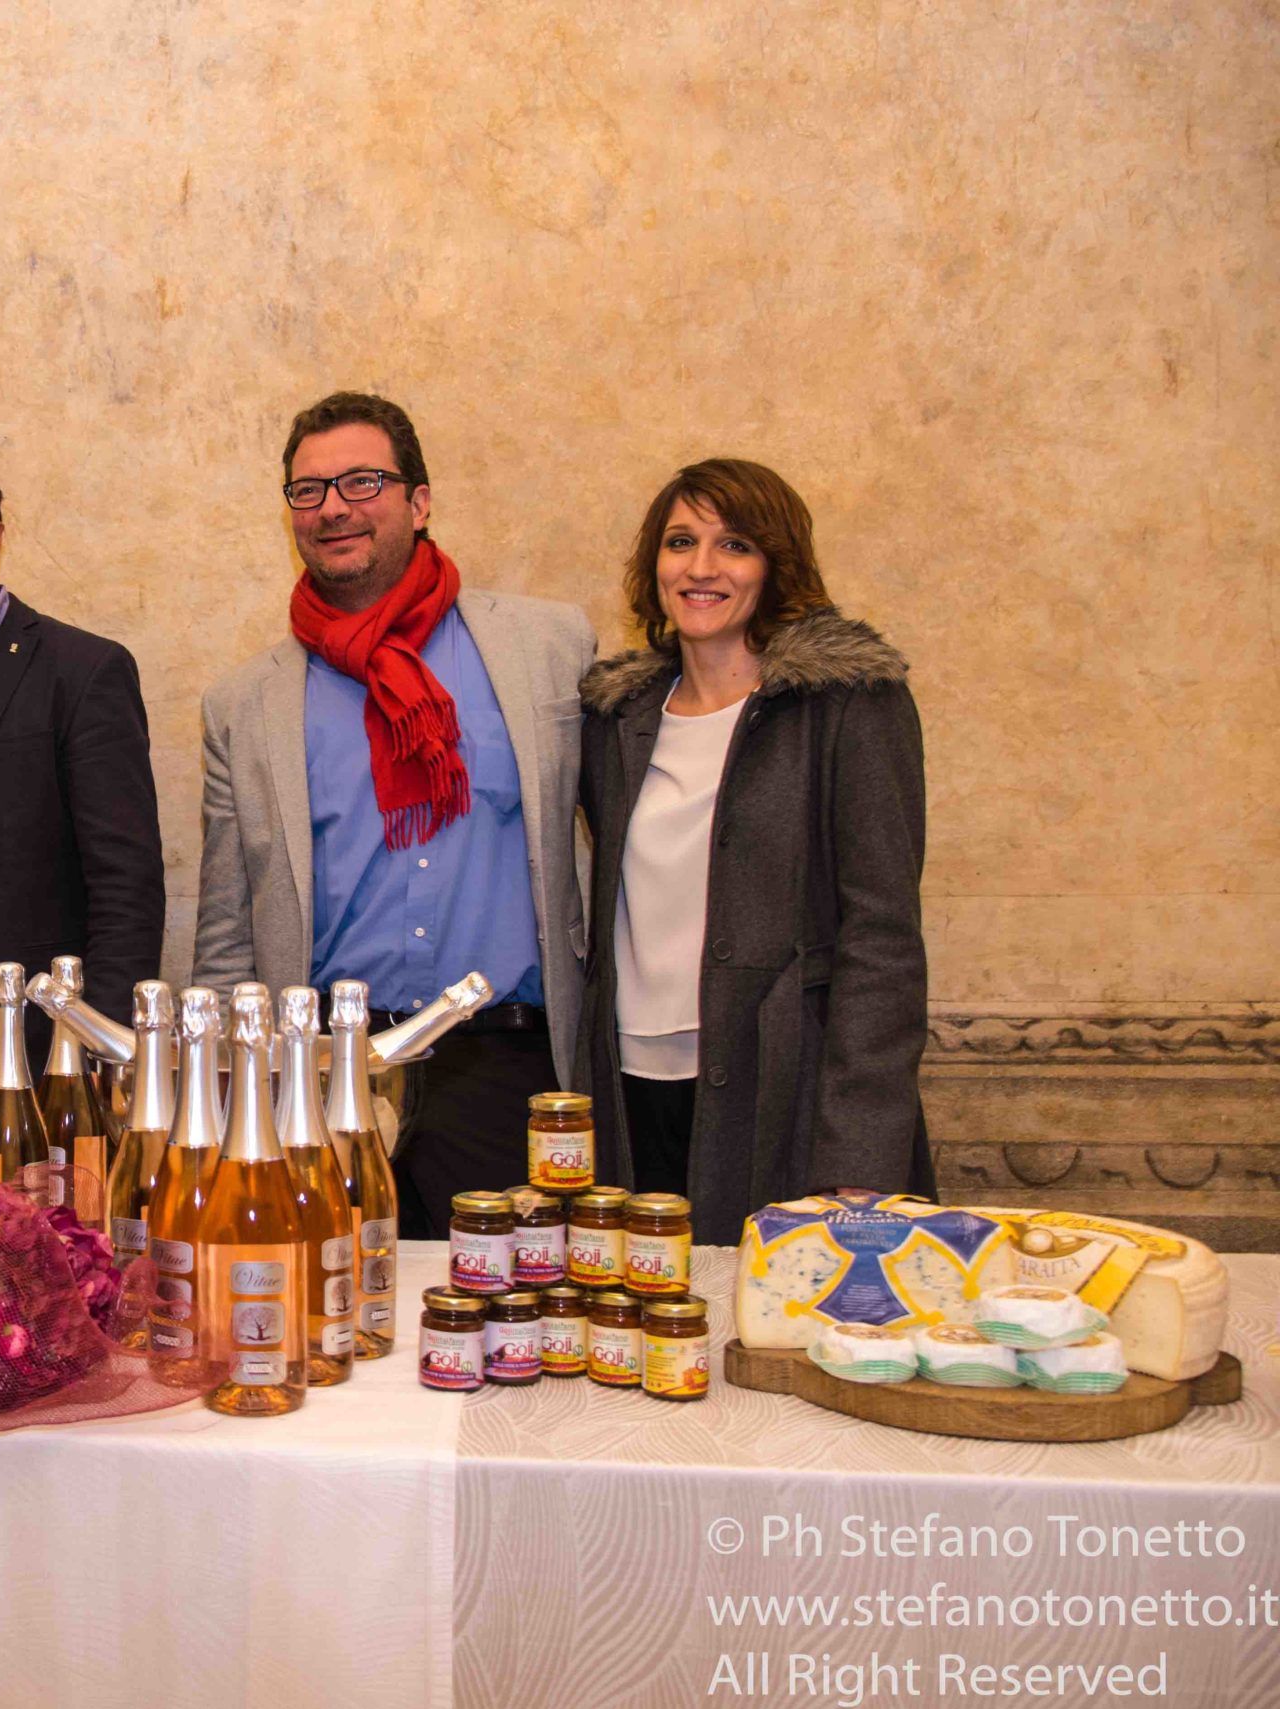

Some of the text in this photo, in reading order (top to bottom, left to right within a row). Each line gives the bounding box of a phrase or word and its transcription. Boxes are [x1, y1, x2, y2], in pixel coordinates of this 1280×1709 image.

[550, 1150, 582, 1169] Goji
[456, 1252, 487, 1271] Goji
[517, 1246, 549, 1264] Goji
[572, 1246, 601, 1266] Goji
[630, 1255, 662, 1274] Goji
[504, 1340, 534, 1357] Goji
[541, 1336, 572, 1355] Goji
[429, 1350, 461, 1369] Goji
[593, 1346, 624, 1366] Goji
